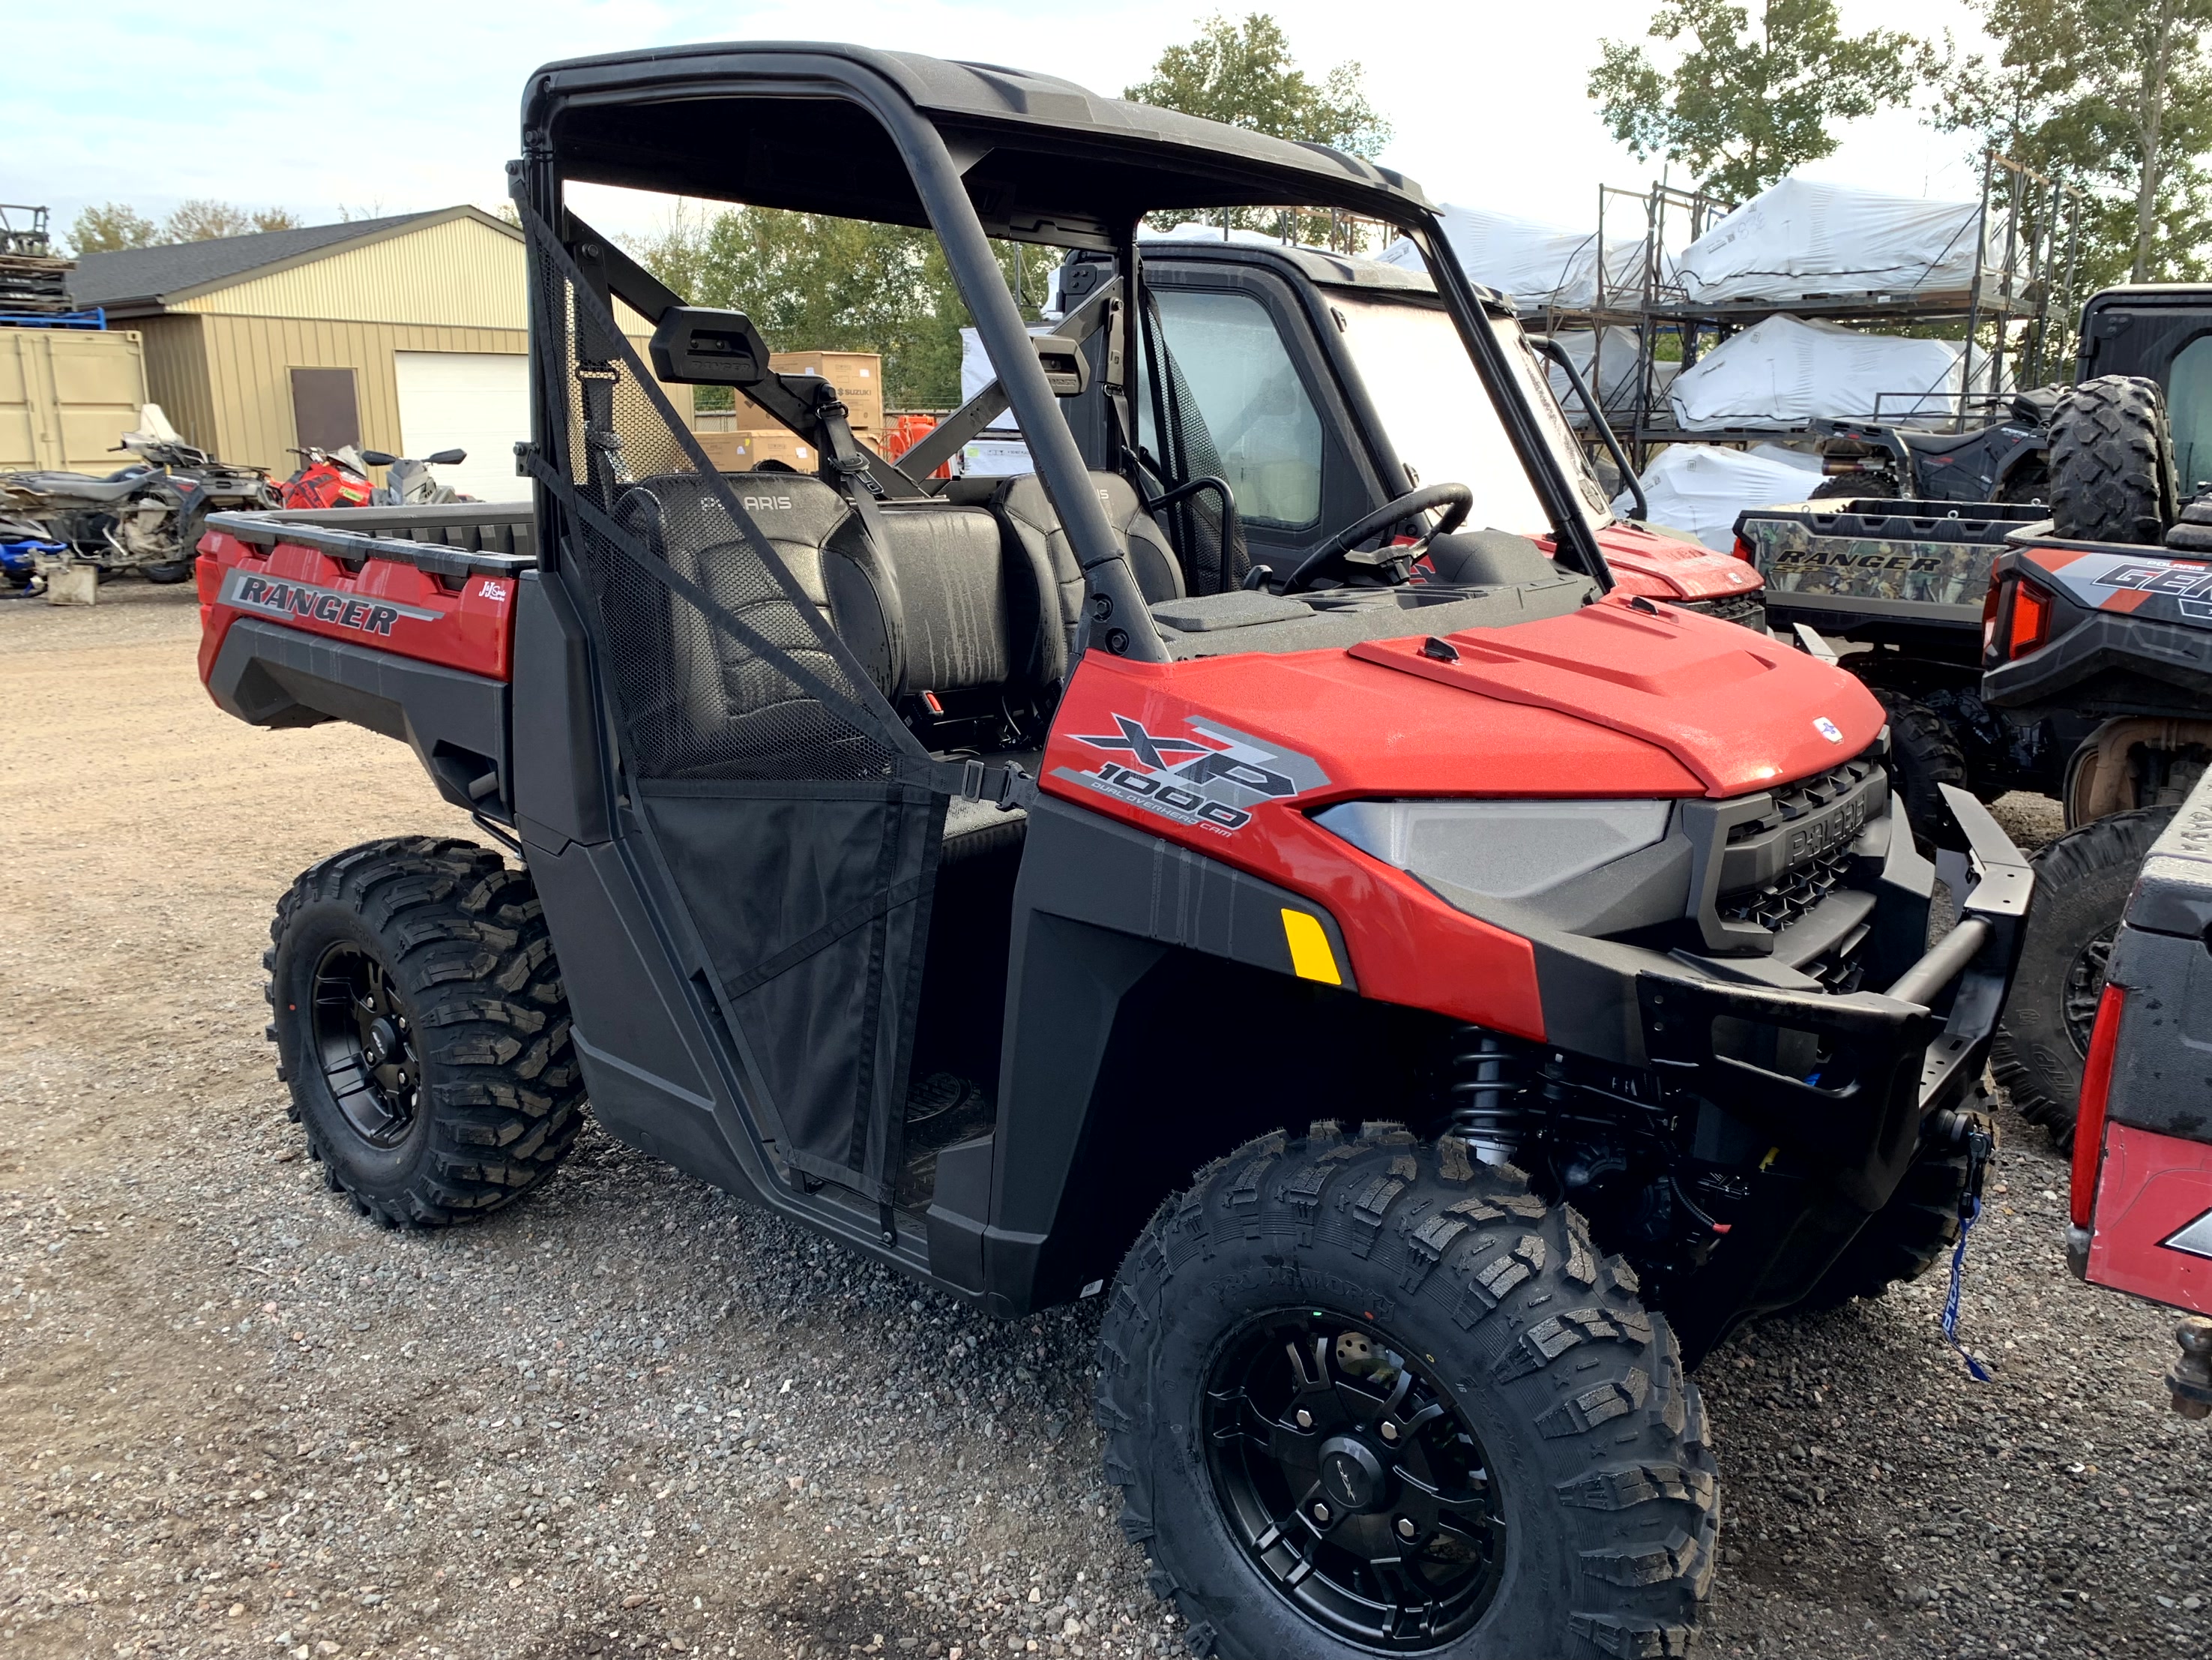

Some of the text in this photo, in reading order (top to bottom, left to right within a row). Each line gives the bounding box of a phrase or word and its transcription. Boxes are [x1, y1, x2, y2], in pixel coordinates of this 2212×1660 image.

[689, 360, 750, 373] RANGER
[700, 496, 792, 511] PARIS
[1771, 564, 1822, 574] SP
[1775, 550, 1941, 573] RANGER
[2147, 560, 2206, 571] POLARIS
[238, 576, 398, 636] RANGER
[1063, 712, 1298, 799] XP
[1091, 781, 1233, 838] DUAL OVERHEAD CAM
[1095, 760, 1253, 831] 1000
[1788, 794, 1864, 866] POLARIS
